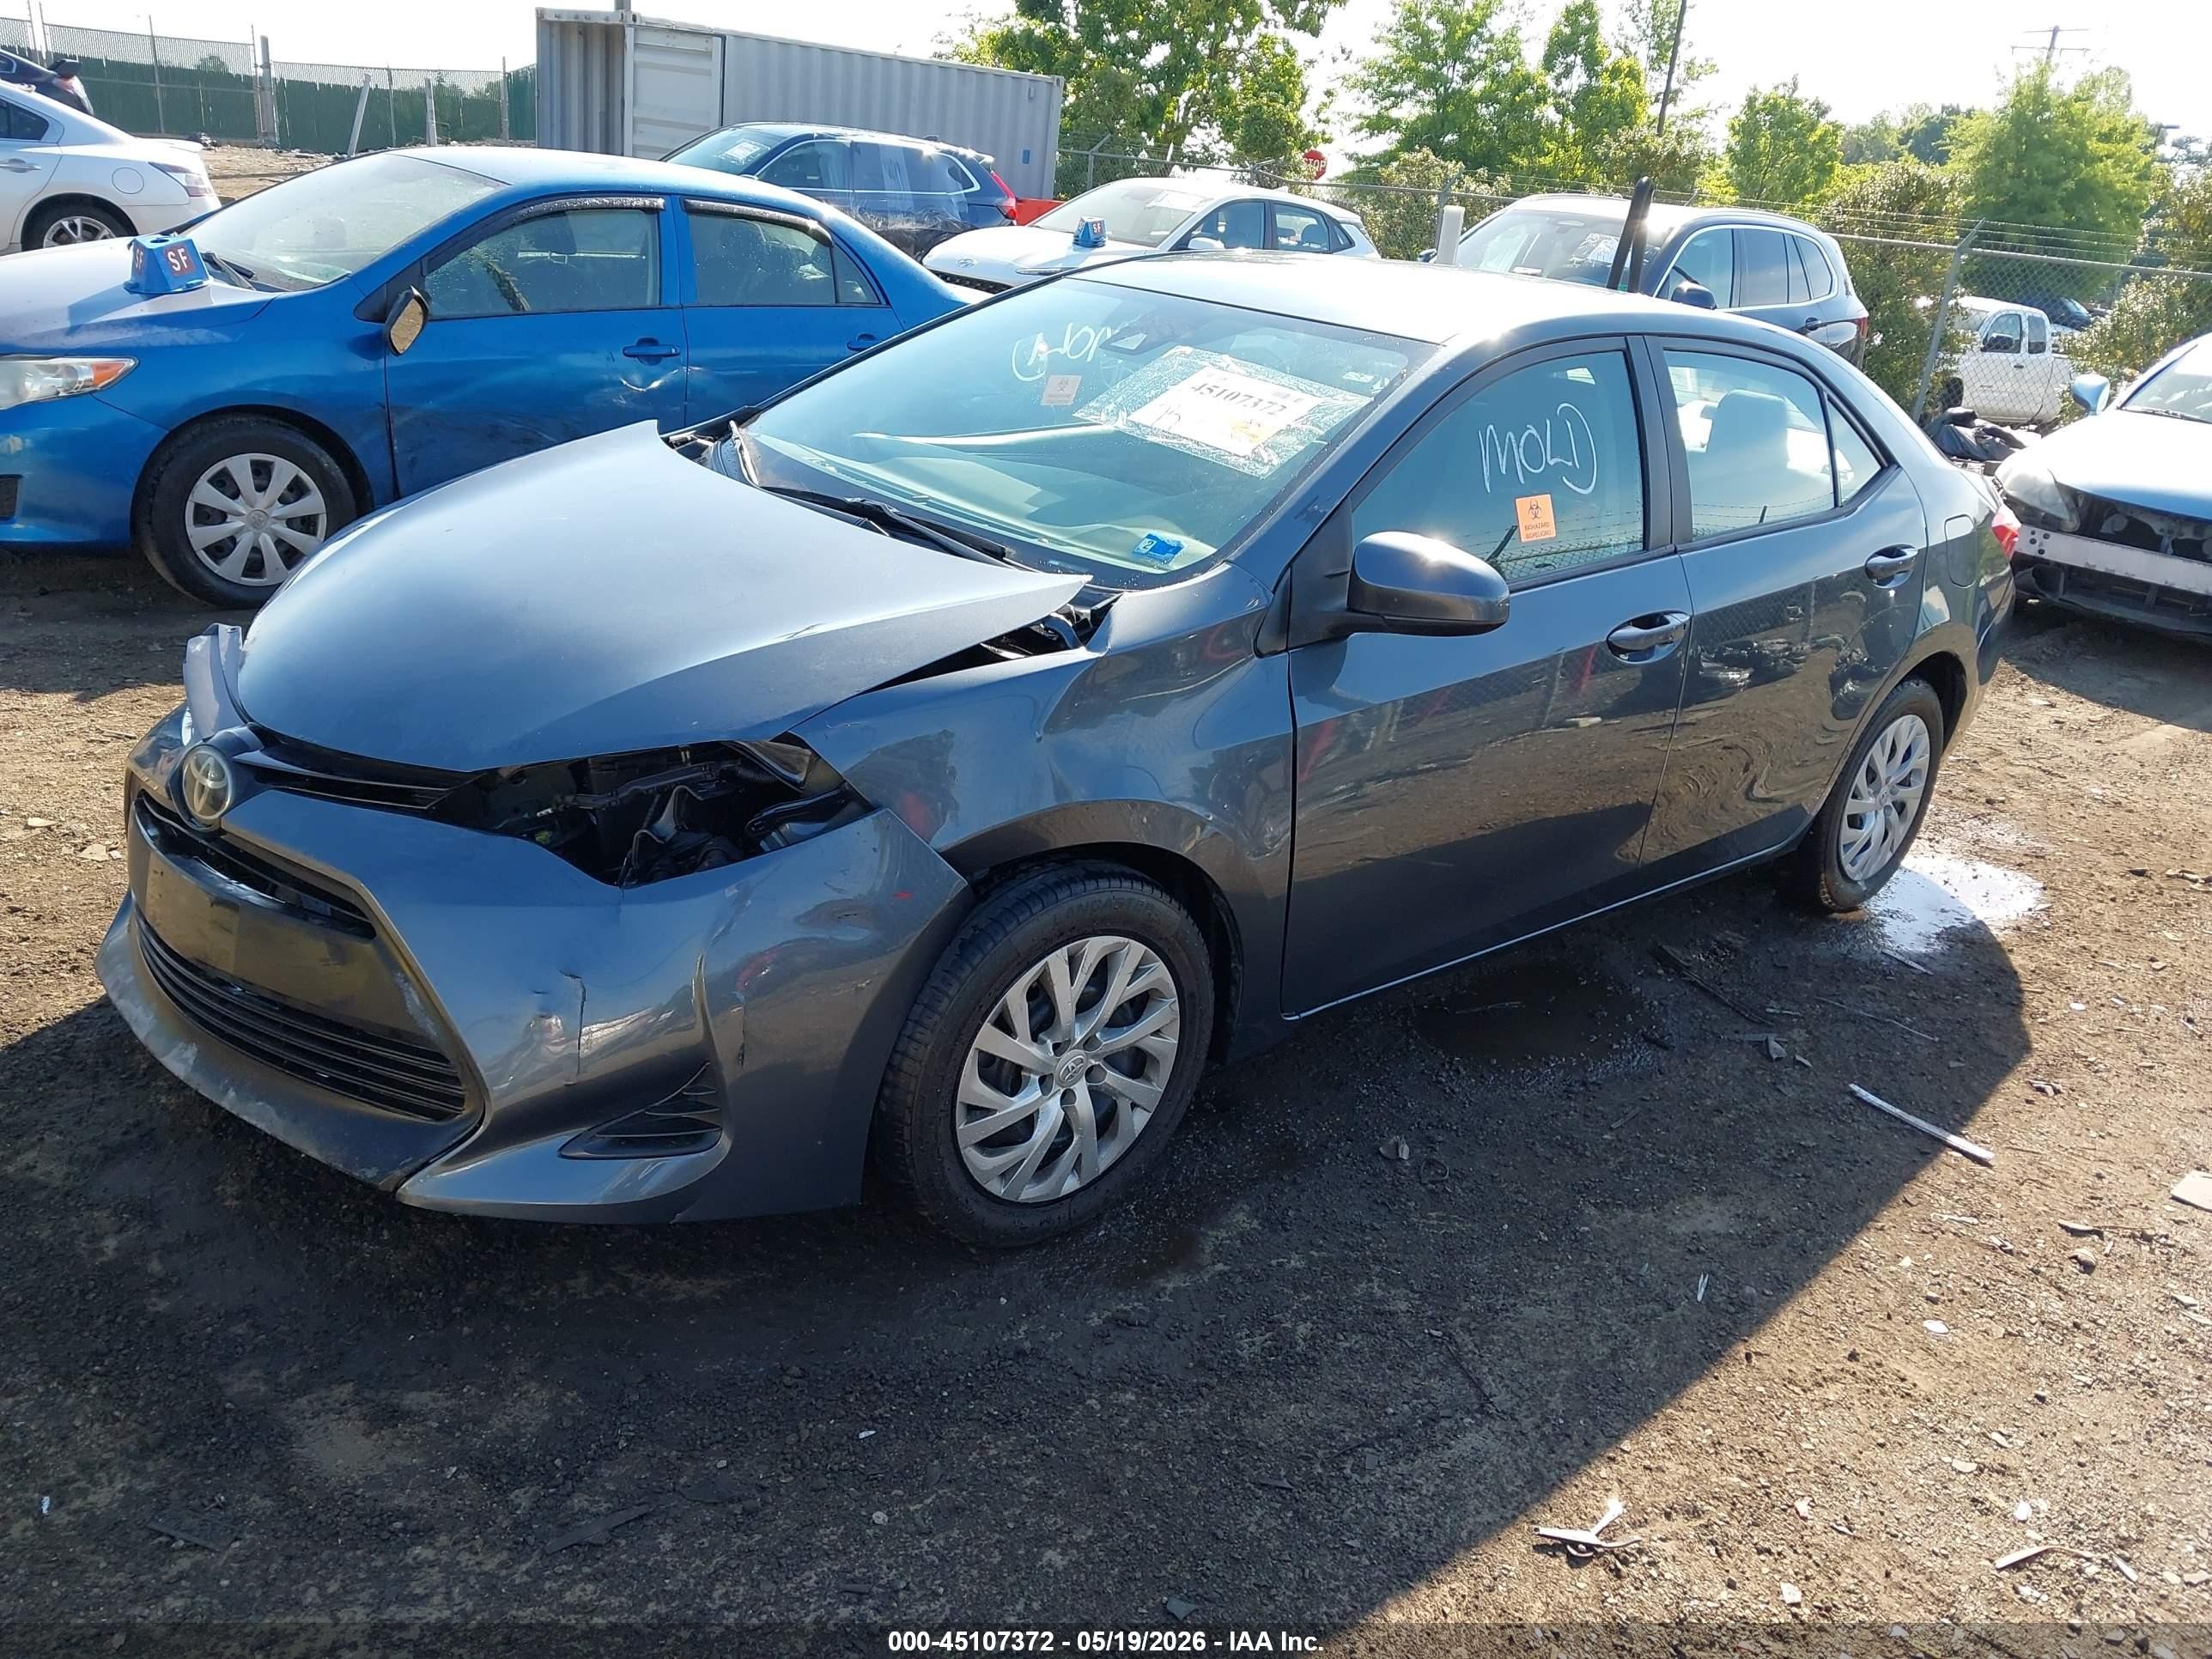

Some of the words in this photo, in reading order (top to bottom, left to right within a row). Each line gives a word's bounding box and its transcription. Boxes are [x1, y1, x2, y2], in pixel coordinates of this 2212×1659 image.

[167, 247, 188, 271] SF
[1191, 383, 1287, 416] 45107372
[1478, 403, 1597, 495] MOLD
[1142, 540, 1155, 550] 2
